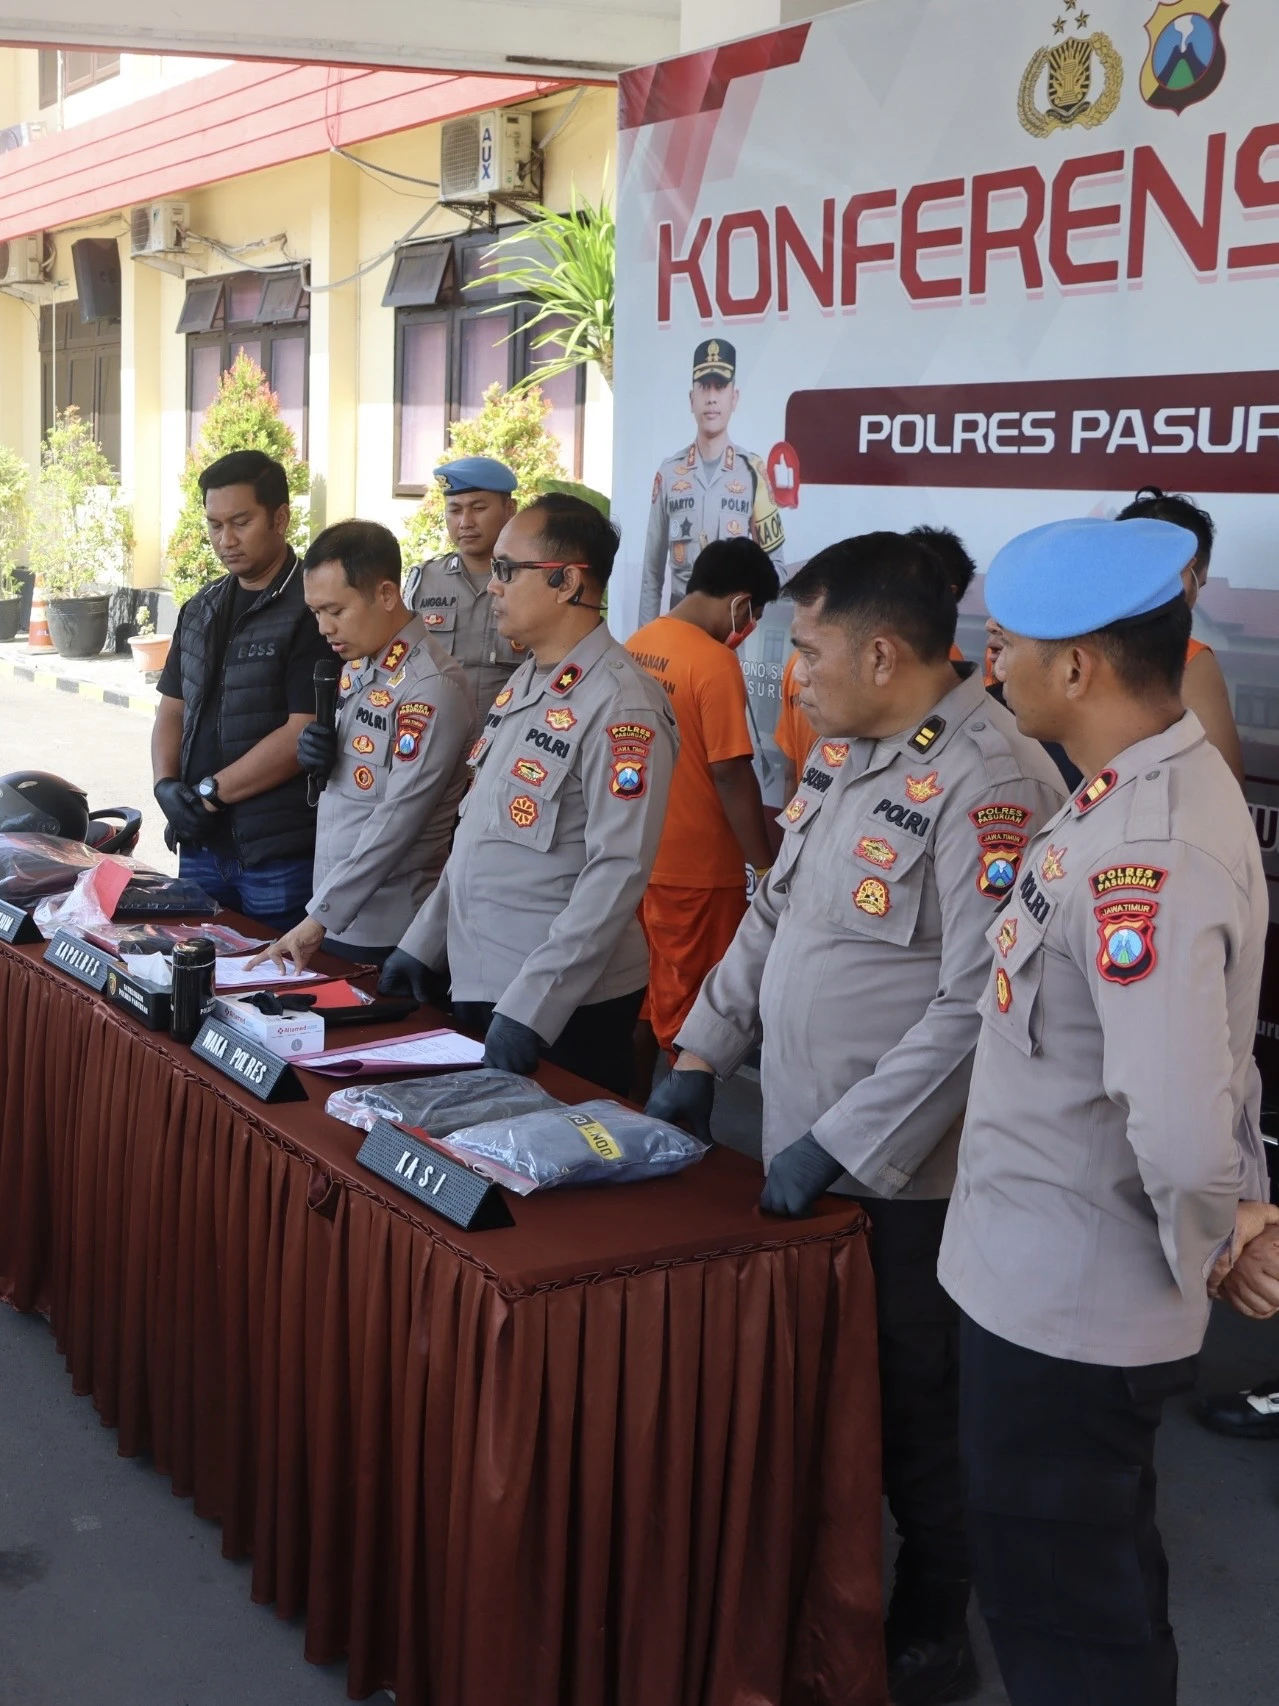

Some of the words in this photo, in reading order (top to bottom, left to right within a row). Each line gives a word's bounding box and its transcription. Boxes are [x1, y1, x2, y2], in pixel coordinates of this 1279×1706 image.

[481, 127, 492, 180] AUX
[656, 123, 1279, 323] KONFERENS
[859, 411, 1056, 454] POLRES
[721, 498, 749, 514] POLRI
[630, 651, 670, 672] AHANAN
[356, 706, 387, 731] POLRI
[612, 725, 651, 737] POLRES
[525, 728, 570, 759] POLRI
[873, 799, 931, 837] POLRI
[977, 807, 1023, 819] POLRES
[977, 814, 1022, 824] PASURUAN
[983, 834, 1001, 842] JAWA
[1002, 833, 1021, 842] TIMUR
[1097, 876, 1157, 892] PASURUAN
[1098, 867, 1154, 881] POLRES
[1102, 904, 1124, 916] JAWA
[1123, 903, 1150, 913] TIMUR
[54, 940, 100, 977] KAPOLRES
[201, 1028, 229, 1060] WAKA
[228, 1047, 268, 1085] POLRES
[393, 1150, 447, 1196] KASI
